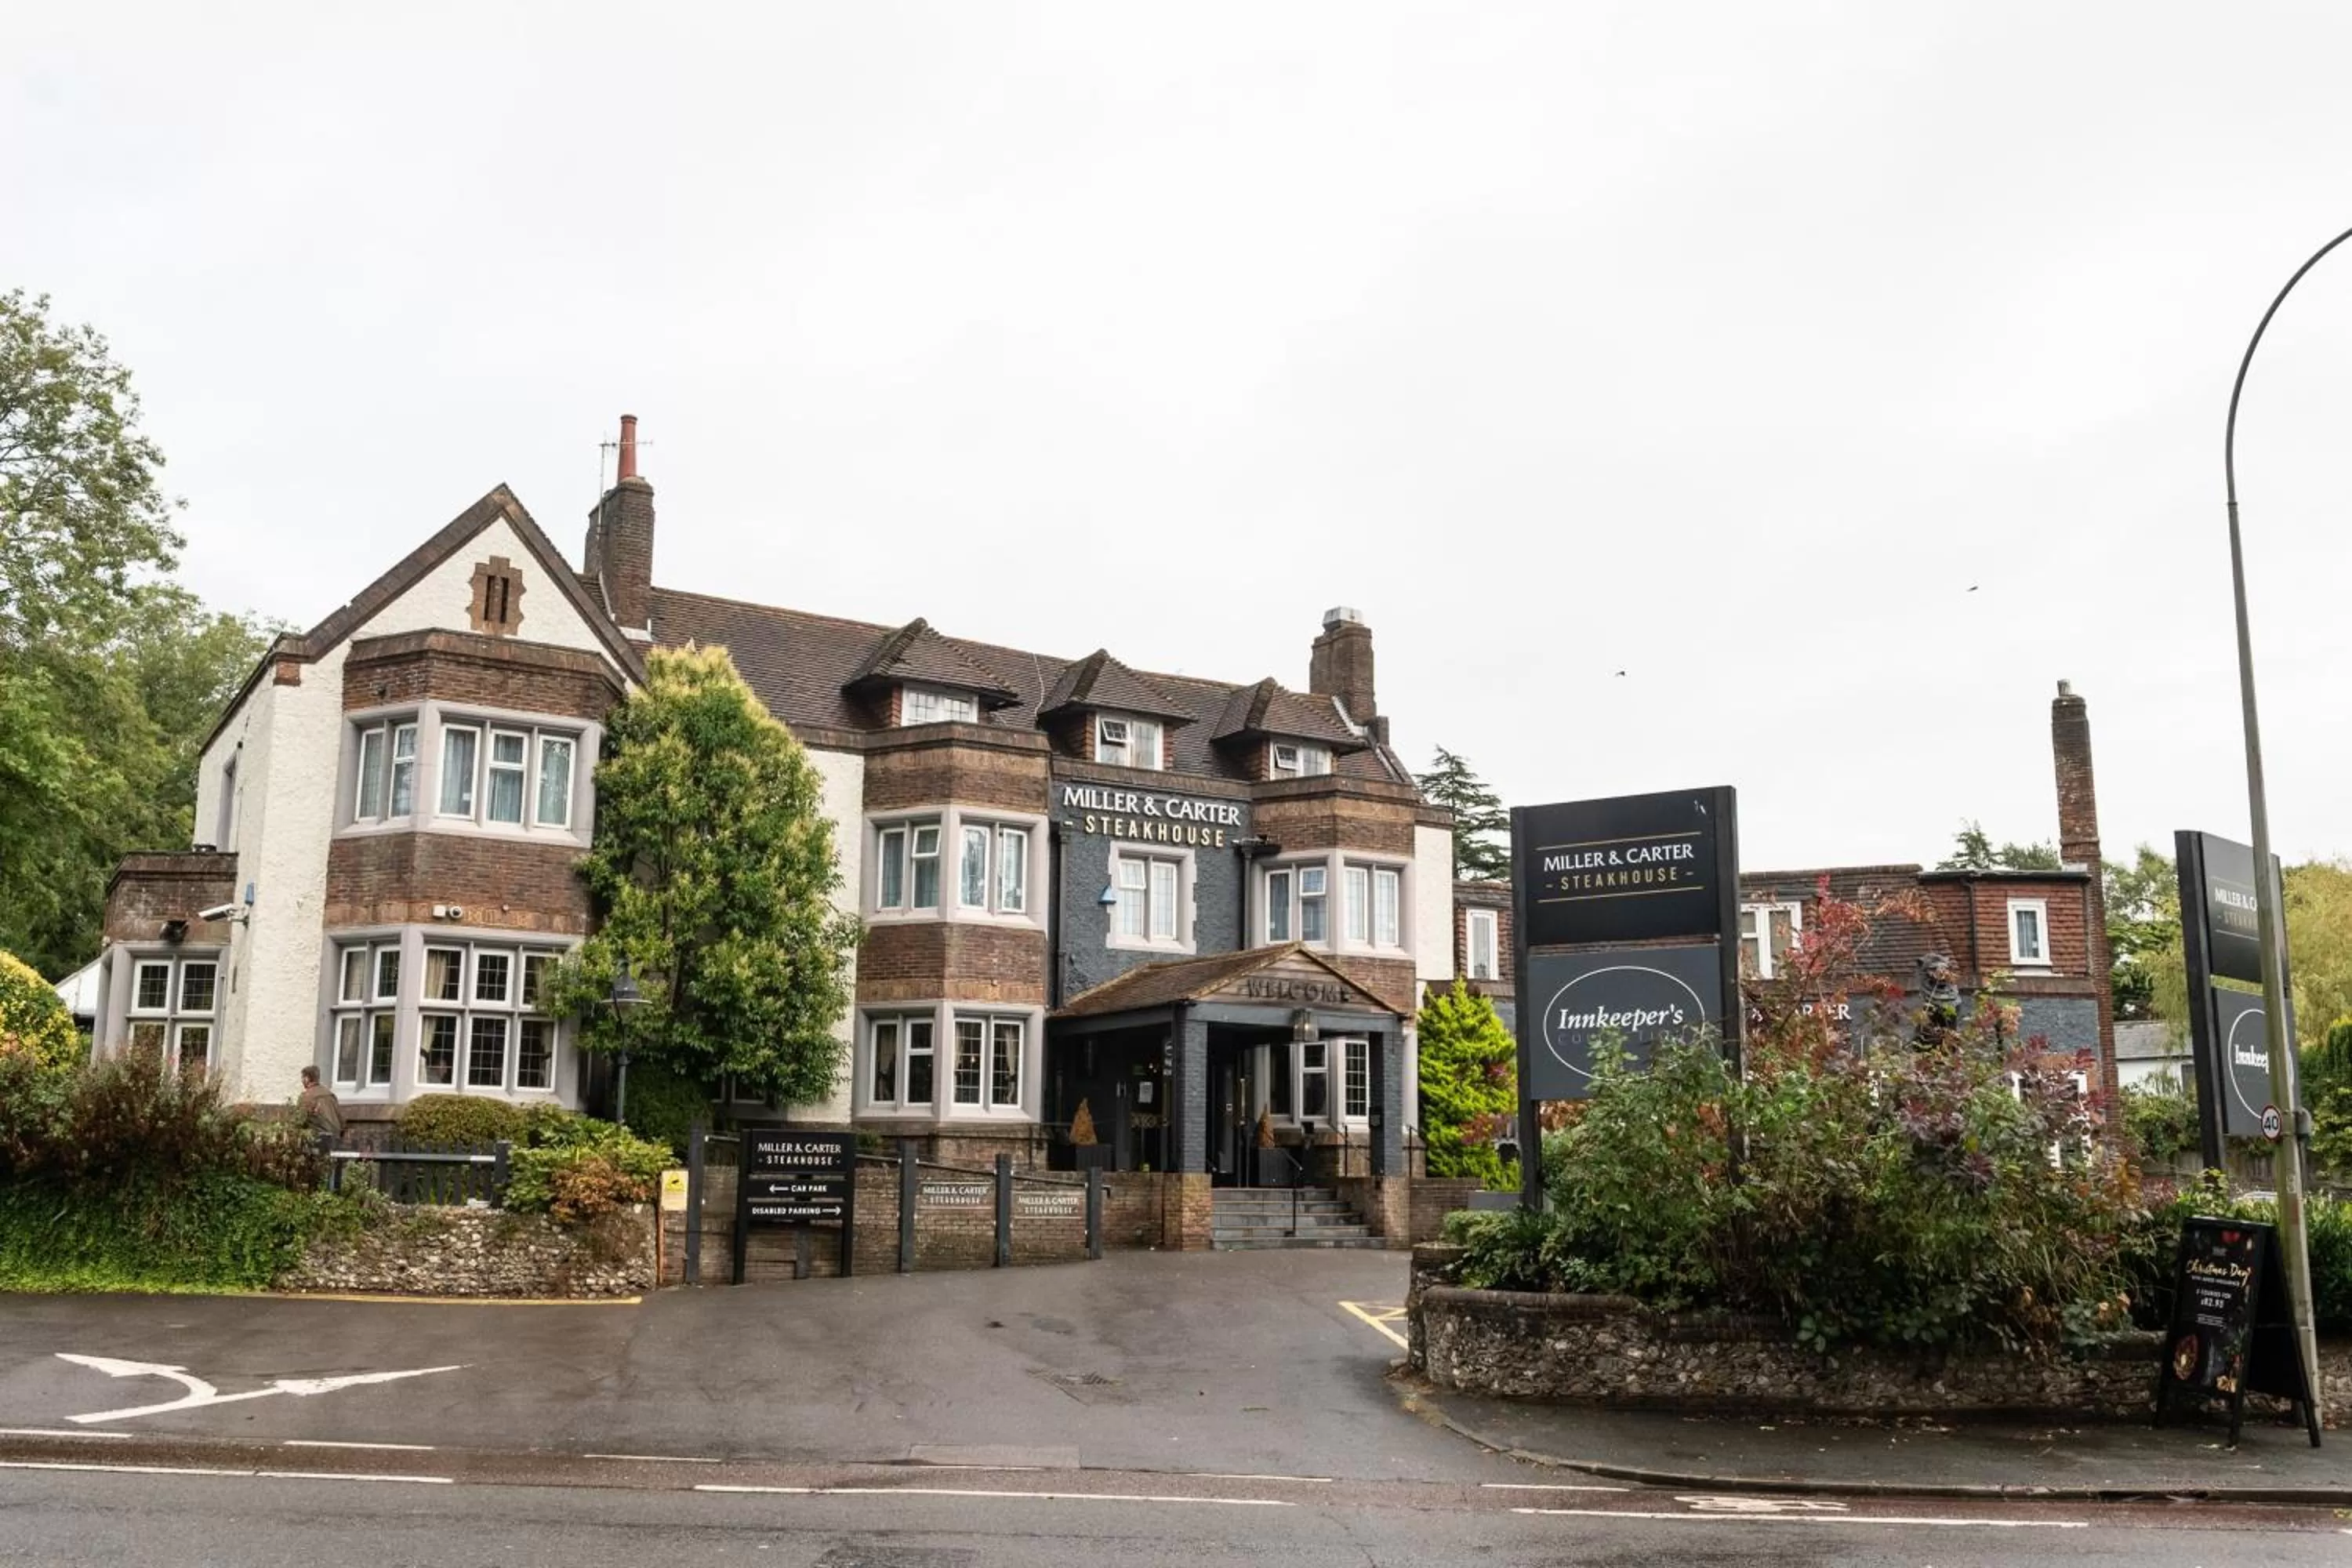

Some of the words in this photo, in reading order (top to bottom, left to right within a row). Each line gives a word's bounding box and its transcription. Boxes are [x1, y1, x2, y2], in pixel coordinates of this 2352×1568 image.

[1063, 786, 1139, 814] MILLER
[1143, 796, 1161, 816] &
[1165, 799, 1241, 826] CARTER
[1085, 815, 1224, 847] STEAKHOUSE
[1544, 852, 1606, 872] MILLER
[1609, 850, 1624, 865] &
[1626, 844, 1694, 863] CARTER
[1561, 867, 1678, 891] STEAKHOUSE
[1558, 1004, 1683, 1032] Innkeeper's
[2264, 1116, 2278, 1131] 40
[757, 1142, 793, 1152] MILLER
[794, 1143, 803, 1152] &
[804, 1144, 841, 1153] CARTER
[767, 1155, 833, 1165] STEAKHOUSE
[923, 1185, 951, 1195] MILLER
[959, 1186, 988, 1196] CARTER
[1018, 1196, 1044, 1204] MILLER
[1051, 1196, 1079, 1206] CARTER
[2230, 1262, 2251, 1286] Day
